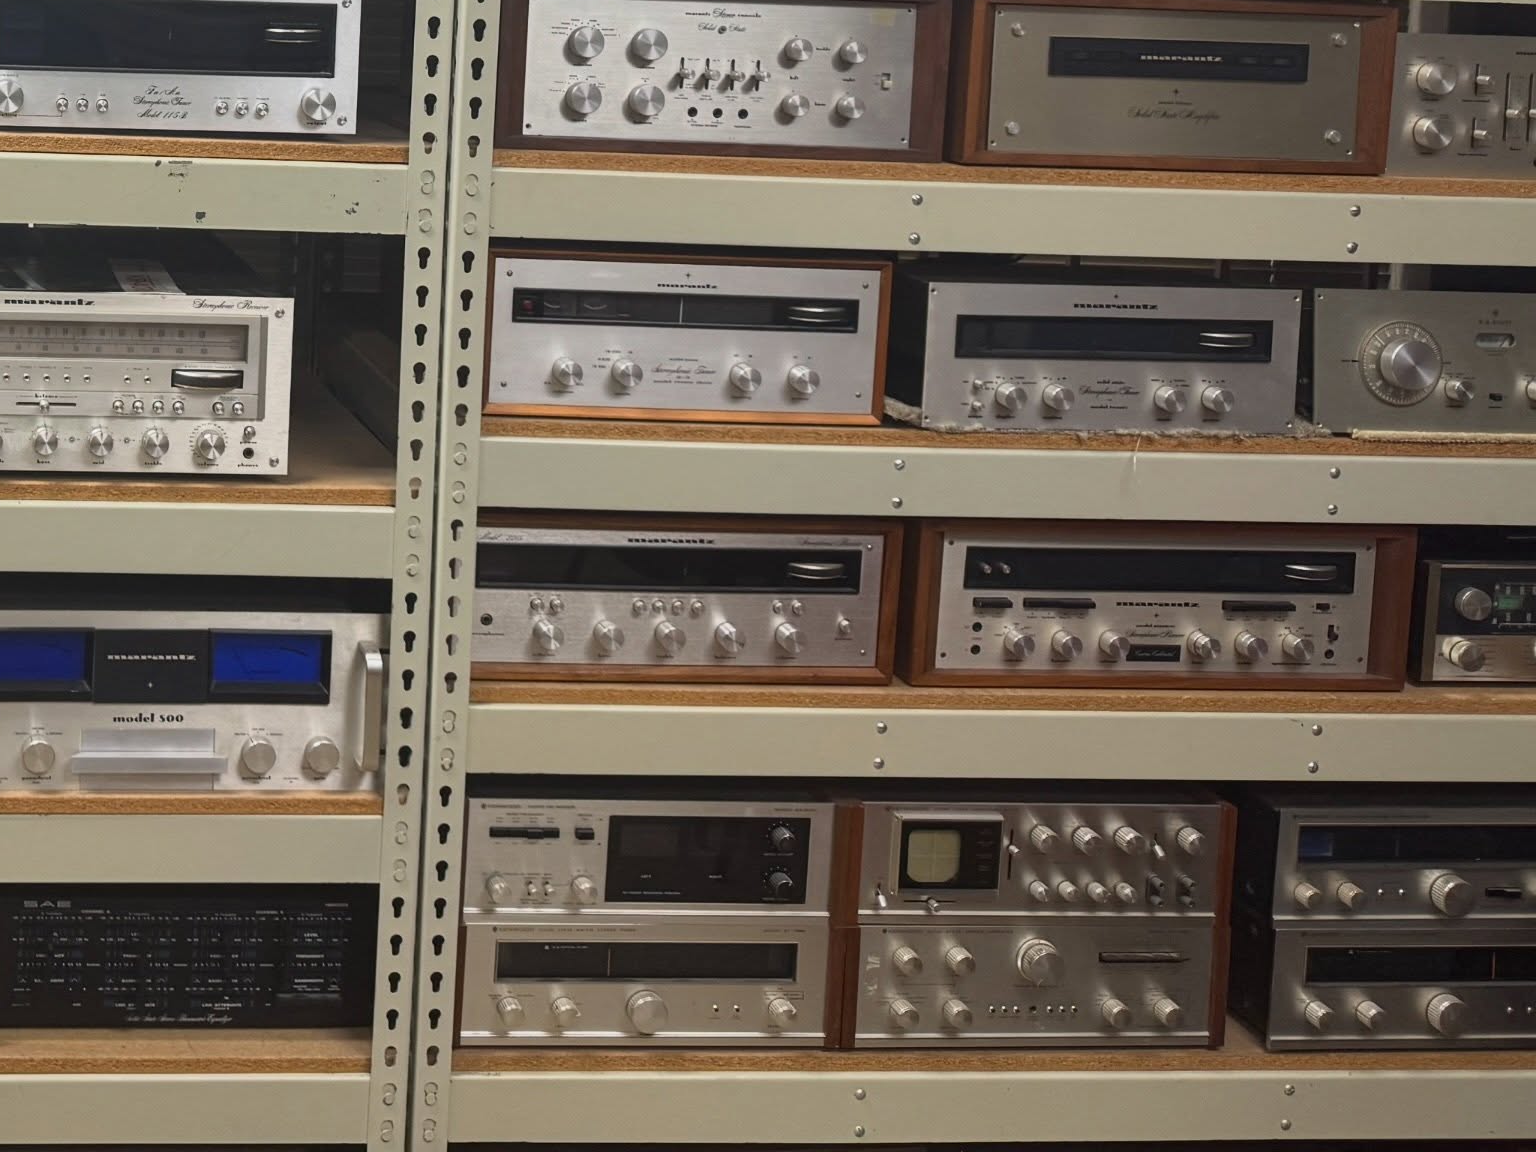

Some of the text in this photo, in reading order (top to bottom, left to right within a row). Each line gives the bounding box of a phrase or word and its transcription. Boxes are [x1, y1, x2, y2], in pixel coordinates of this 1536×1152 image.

[1139, 52, 1224, 64] marantz
[1073, 302, 1159, 311] marantz
[107, 653, 196, 662] marantz
[113, 712, 184, 723] model 500
[23, 900, 72, 908] SAE
